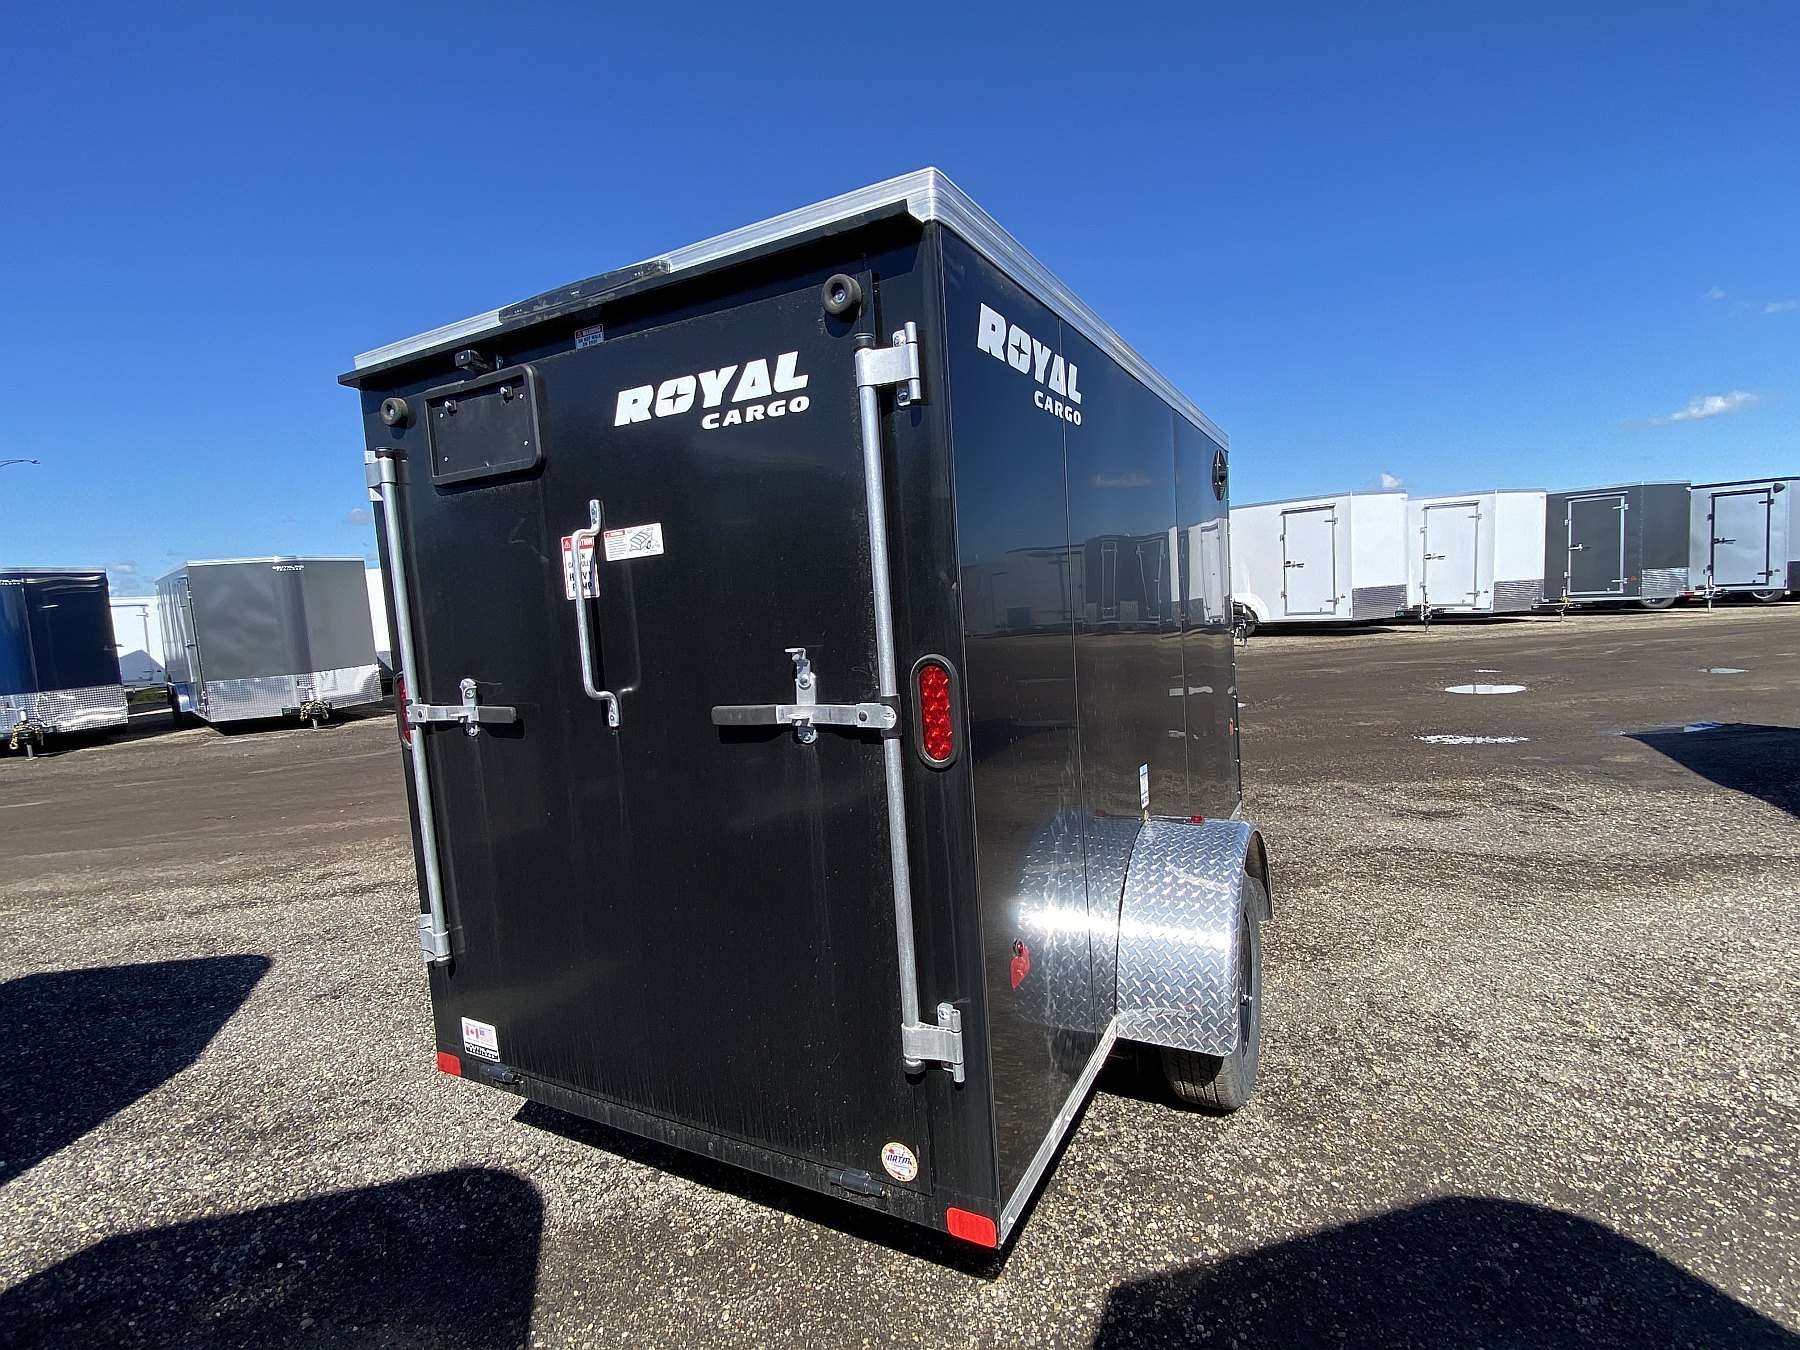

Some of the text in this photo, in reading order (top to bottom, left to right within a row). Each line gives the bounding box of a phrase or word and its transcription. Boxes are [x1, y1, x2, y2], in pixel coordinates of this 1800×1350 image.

[977, 302, 1081, 405] ROYAL
[614, 351, 809, 427] ROYAL
[701, 396, 810, 430] CARGO
[1034, 390, 1082, 426] CARGO
